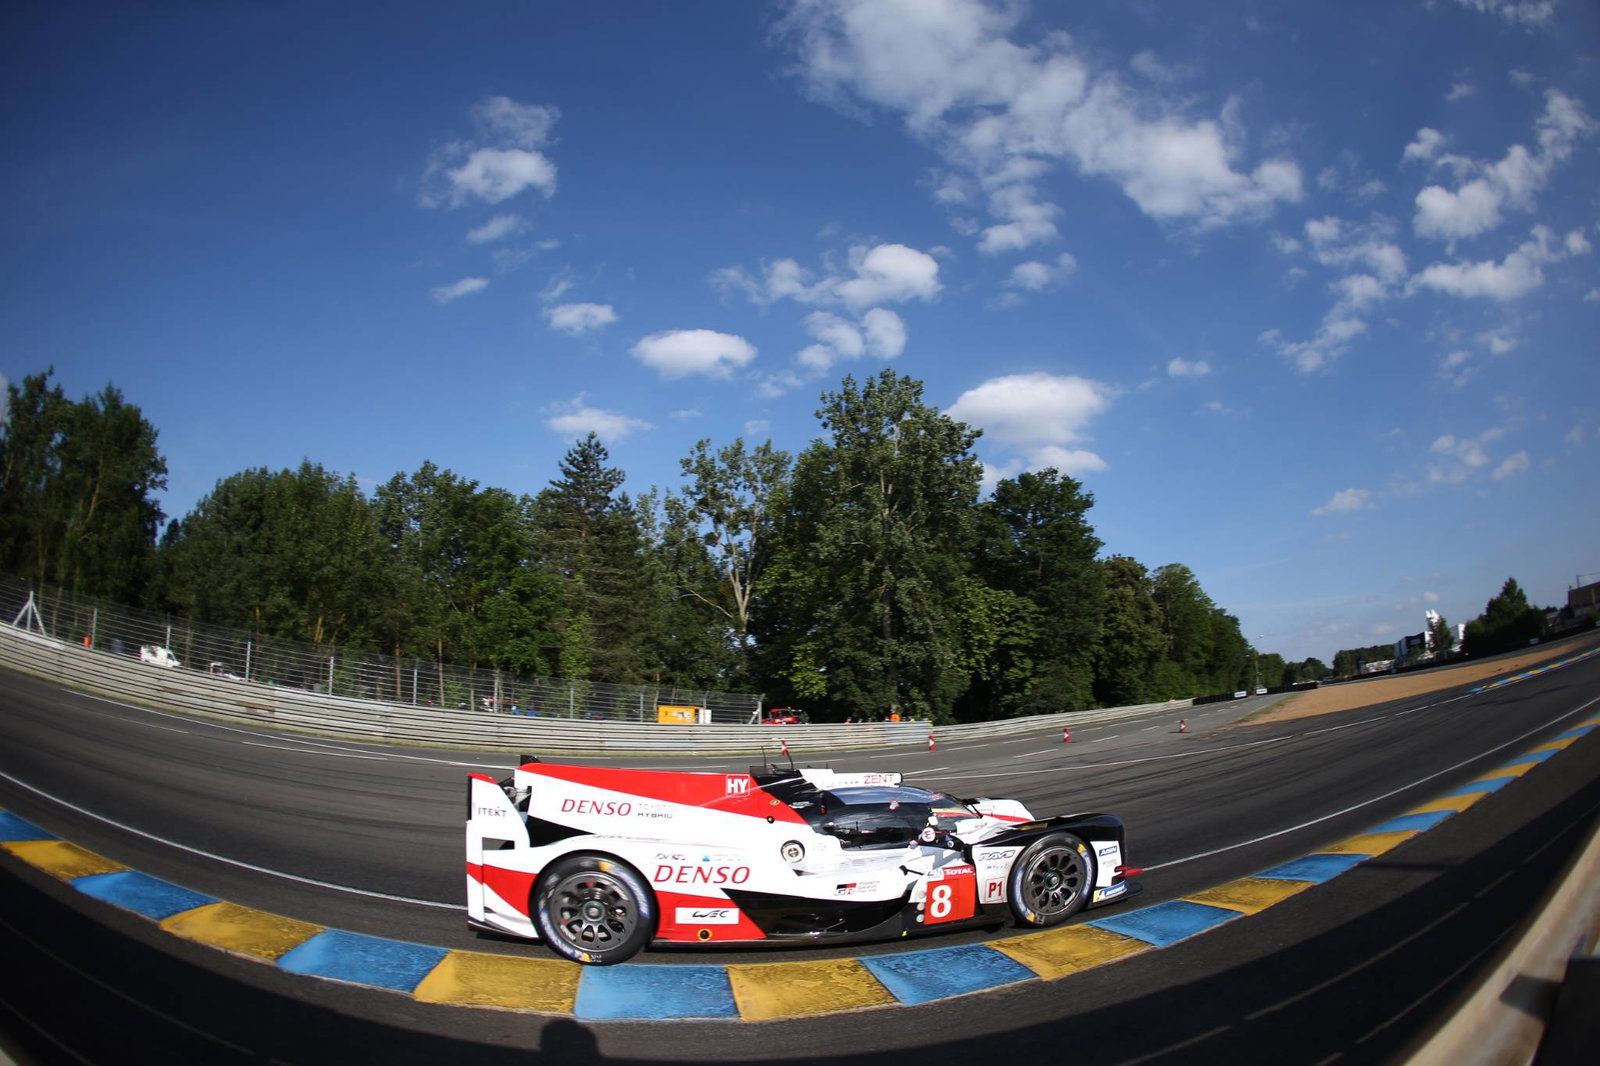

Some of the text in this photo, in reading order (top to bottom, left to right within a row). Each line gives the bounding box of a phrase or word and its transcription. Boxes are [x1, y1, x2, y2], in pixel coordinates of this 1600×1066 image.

[727, 778, 749, 794] HY
[863, 774, 895, 785] ZENT
[560, 798, 632, 817] DENSO
[978, 849, 1016, 862] RAYS
[653, 864, 751, 885] DENSO
[943, 867, 973, 876] TOTAL
[988, 880, 1003, 898] P1
[930, 884, 953, 919] 8
